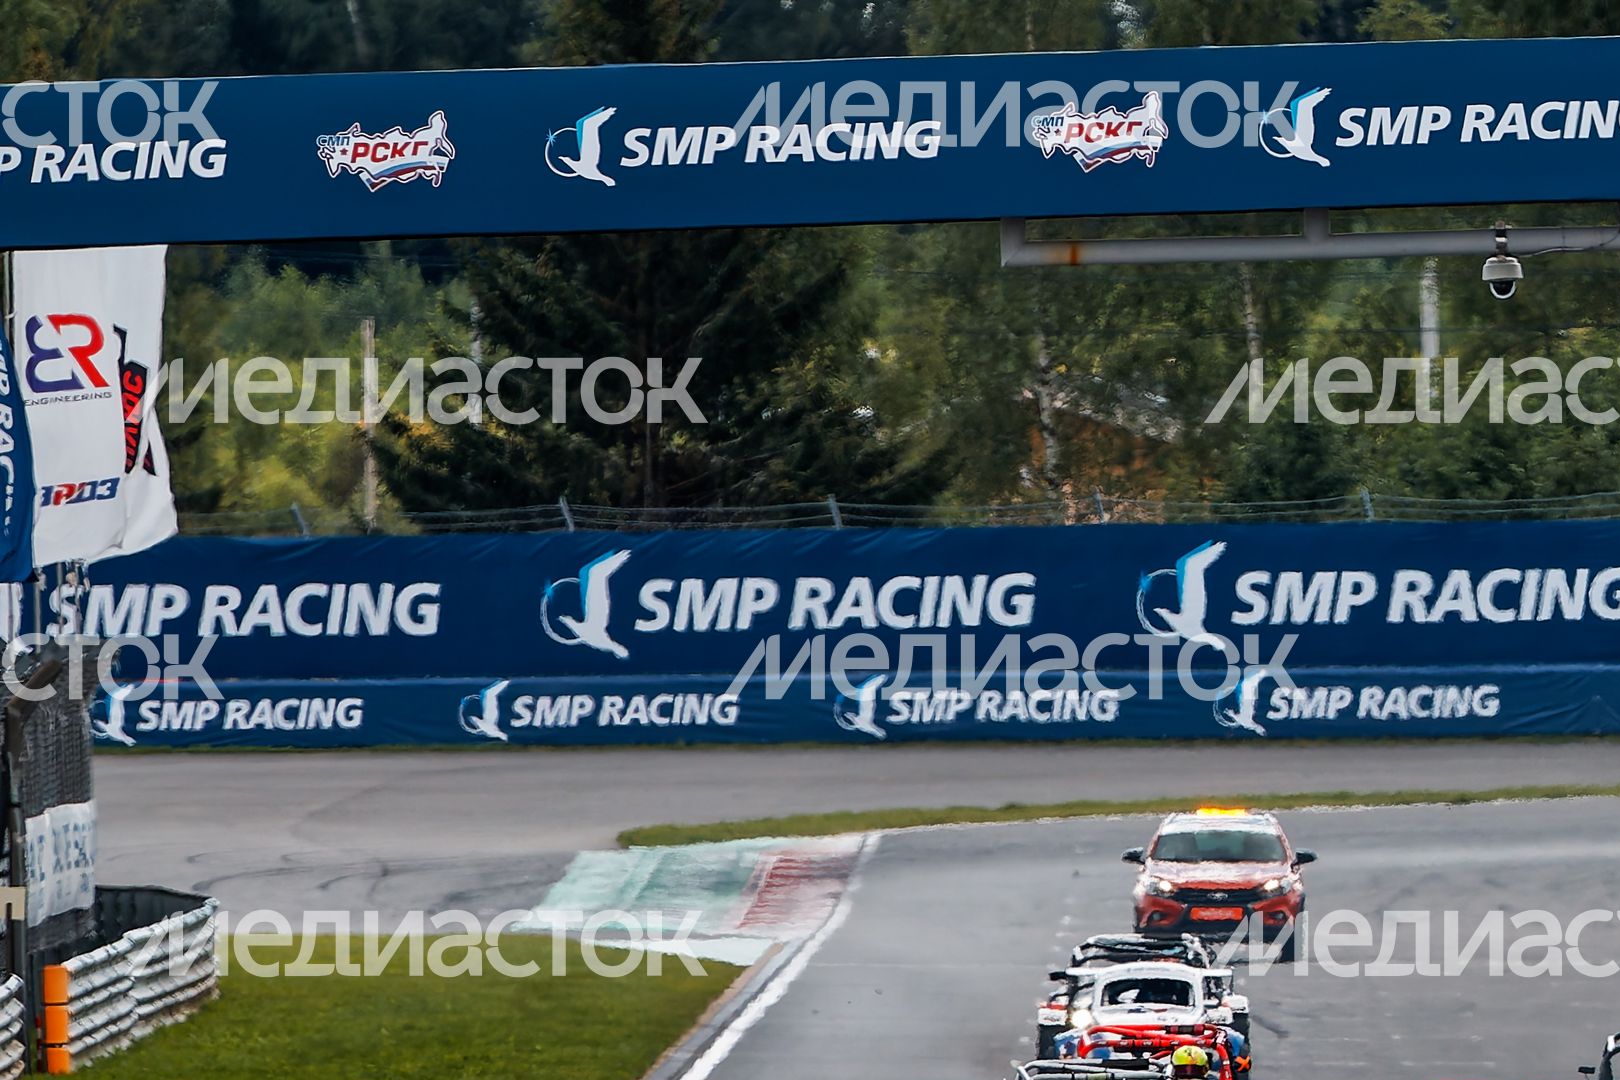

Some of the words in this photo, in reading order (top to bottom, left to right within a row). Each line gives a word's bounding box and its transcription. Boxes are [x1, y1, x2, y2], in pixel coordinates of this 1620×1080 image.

[621, 125, 737, 167] SMP
[746, 119, 942, 163] RACING
[1064, 121, 1143, 144] РСКГ
[1336, 107, 1451, 147] SMP
[31, 139, 227, 183] RACING
[350, 141, 429, 163] РСКГ
[47, 583, 188, 640] SMP
[199, 583, 440, 637] RACING
[636, 578, 777, 632] SMP
[791, 573, 1035, 630] RACING
[1232, 571, 1376, 625] SMP
[138, 700, 221, 730] SMP
[225, 698, 363, 730] RACING
[511, 695, 593, 727] SMP
[599, 693, 740, 726] RACING
[887, 690, 972, 722] SMP
[977, 688, 1121, 721] RACING
[1267, 686, 1352, 719] SMP
[1359, 685, 1499, 718] RACING
